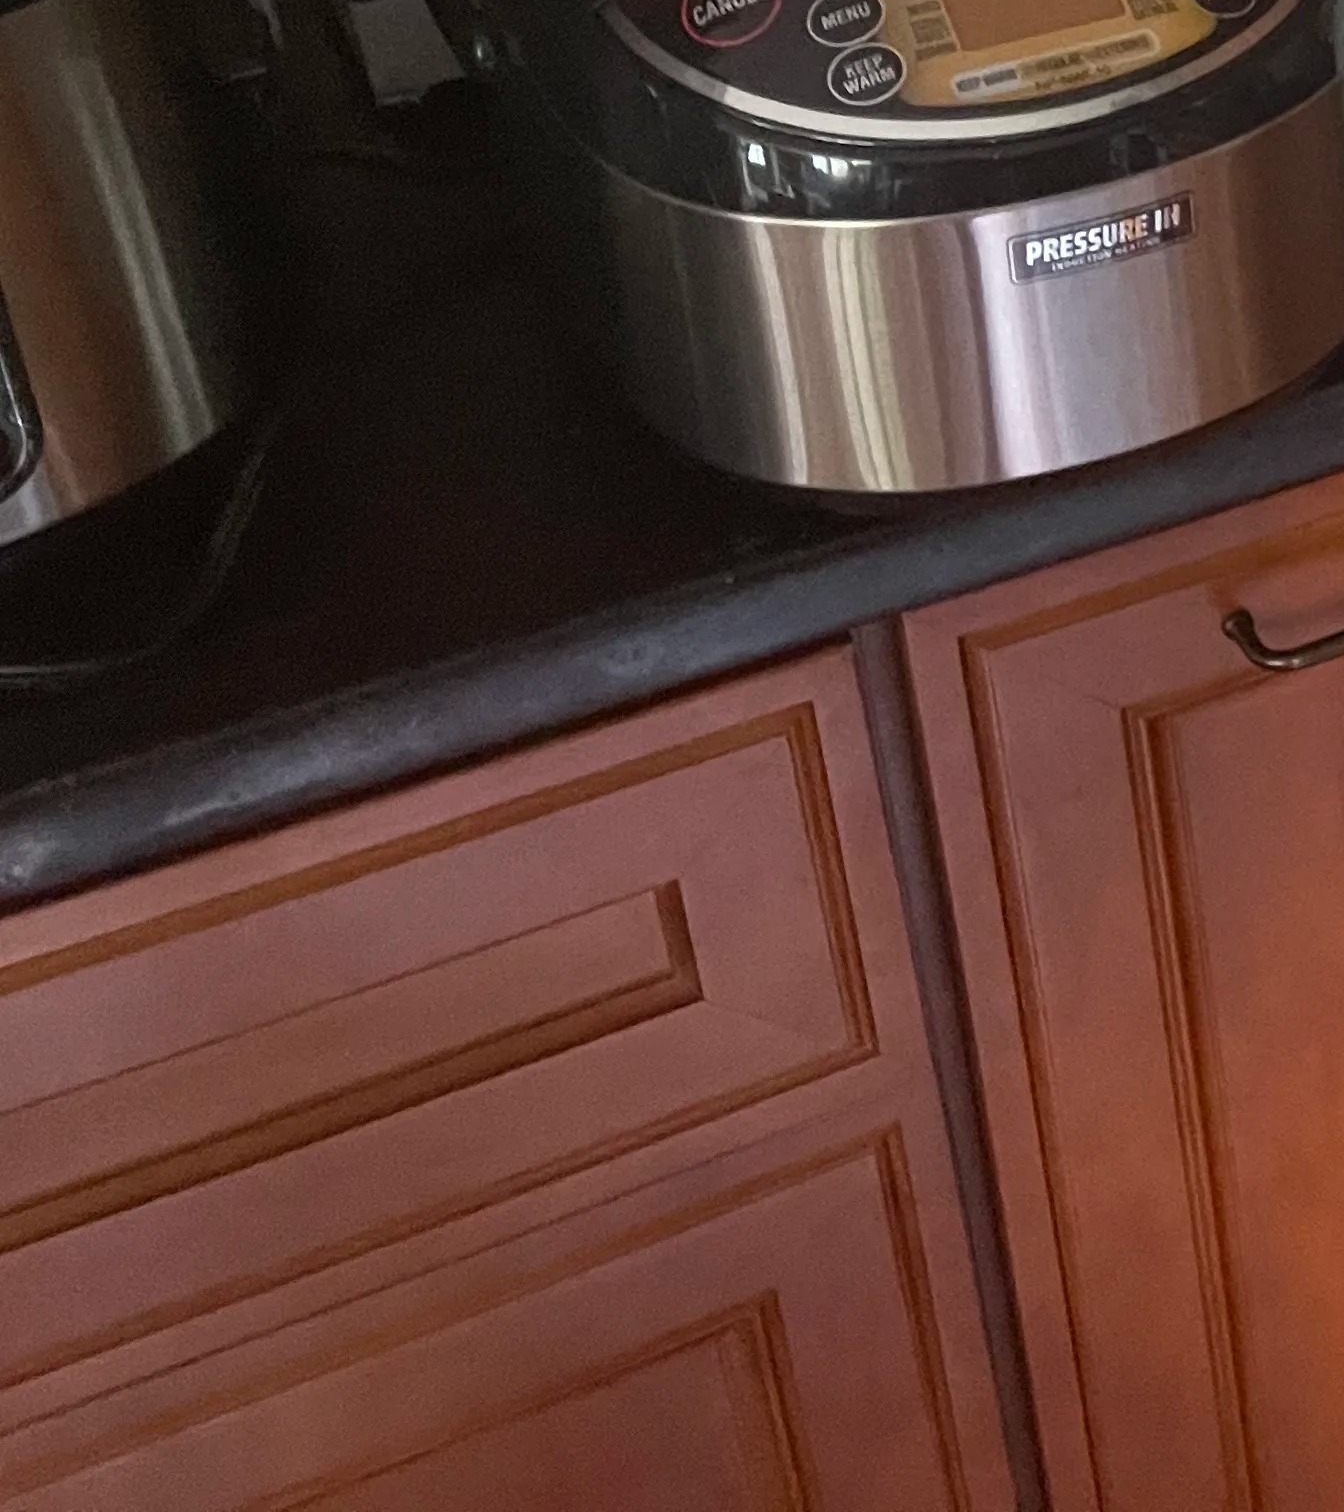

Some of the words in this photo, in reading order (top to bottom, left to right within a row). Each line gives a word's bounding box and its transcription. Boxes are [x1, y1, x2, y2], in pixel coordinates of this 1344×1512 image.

[820, 0, 872, 30] MENU
[843, 66, 896, 95] WARM
[844, 53, 884, 79] KEEP
[1026, 213, 1149, 266] PRESSURE
